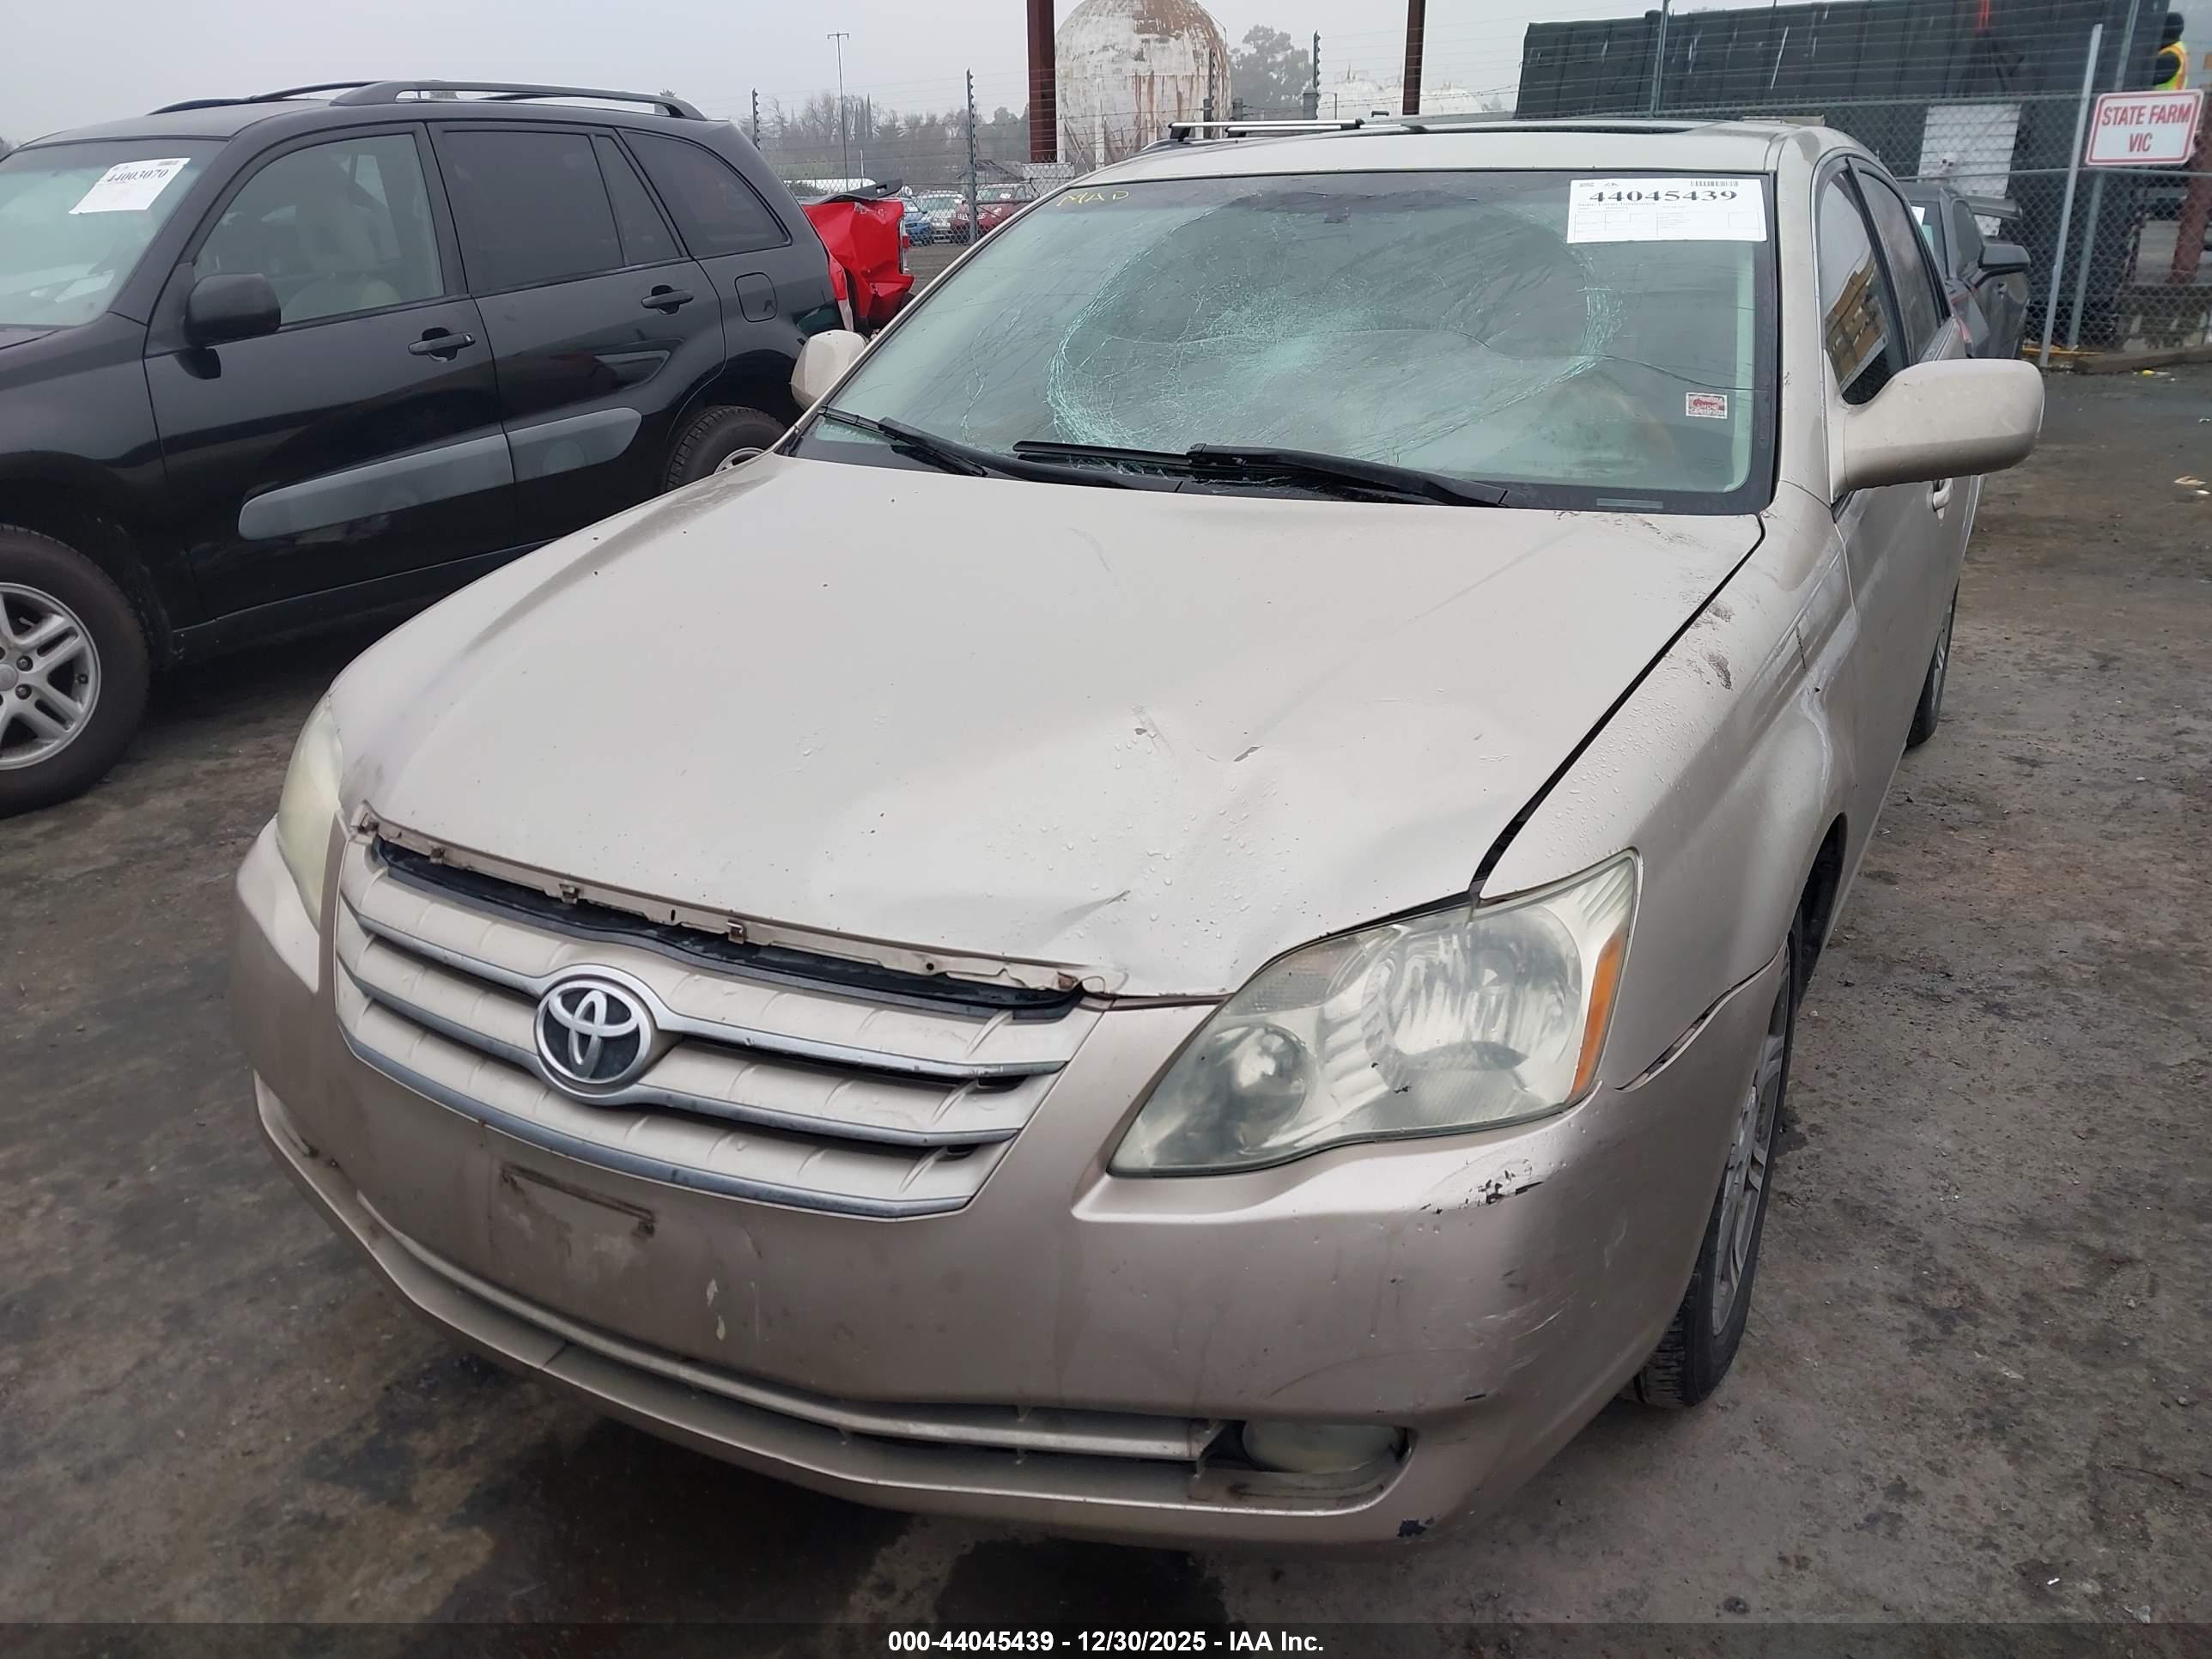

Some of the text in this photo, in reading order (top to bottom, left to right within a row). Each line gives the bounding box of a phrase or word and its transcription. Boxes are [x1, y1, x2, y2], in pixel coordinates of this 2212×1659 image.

[2101, 103, 2192, 126] STATE FARM
[2128, 132, 2154, 153] VIC
[1589, 191, 1737, 203] 44045439
